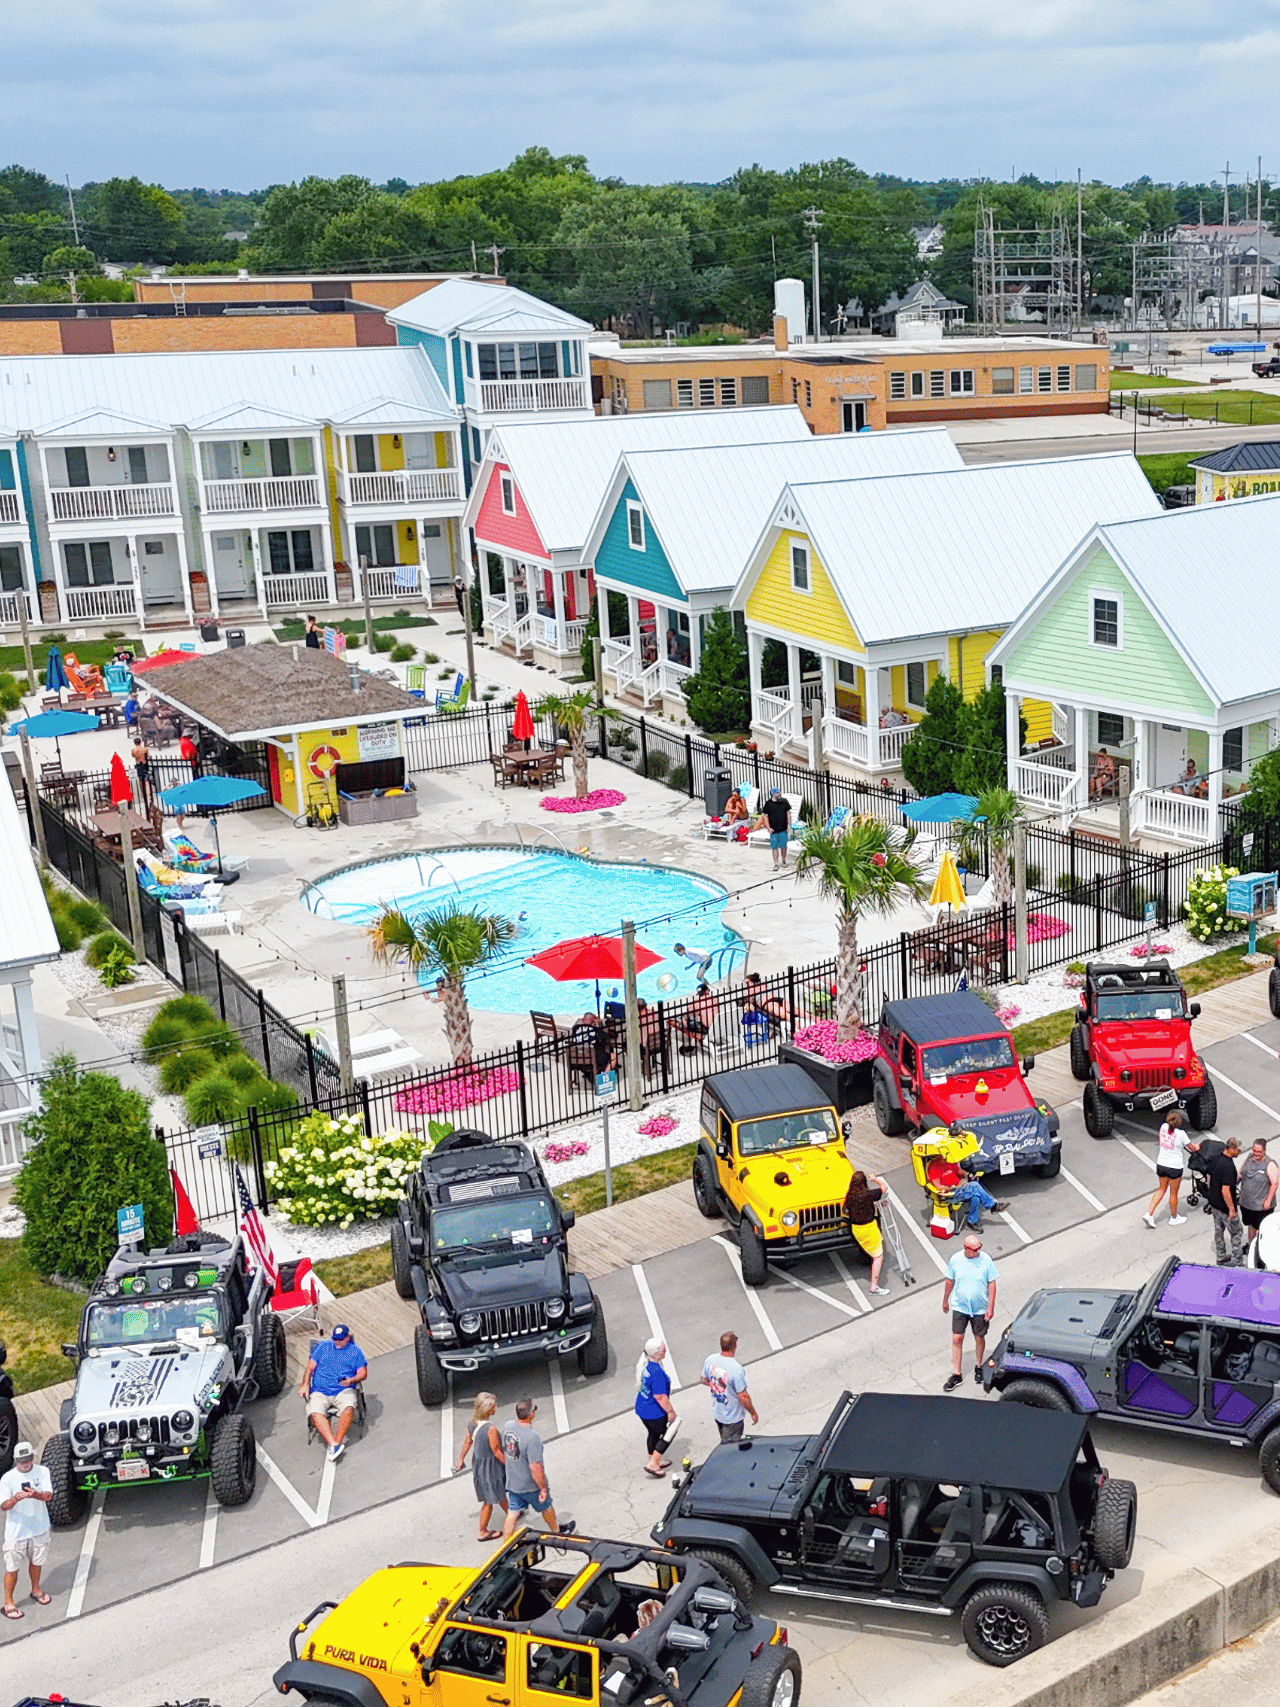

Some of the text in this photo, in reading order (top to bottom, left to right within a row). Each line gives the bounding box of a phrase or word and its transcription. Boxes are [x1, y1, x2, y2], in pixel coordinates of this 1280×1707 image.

[126, 1209, 135, 1219] 15
[325, 1644, 387, 1671] PURA VIDA
